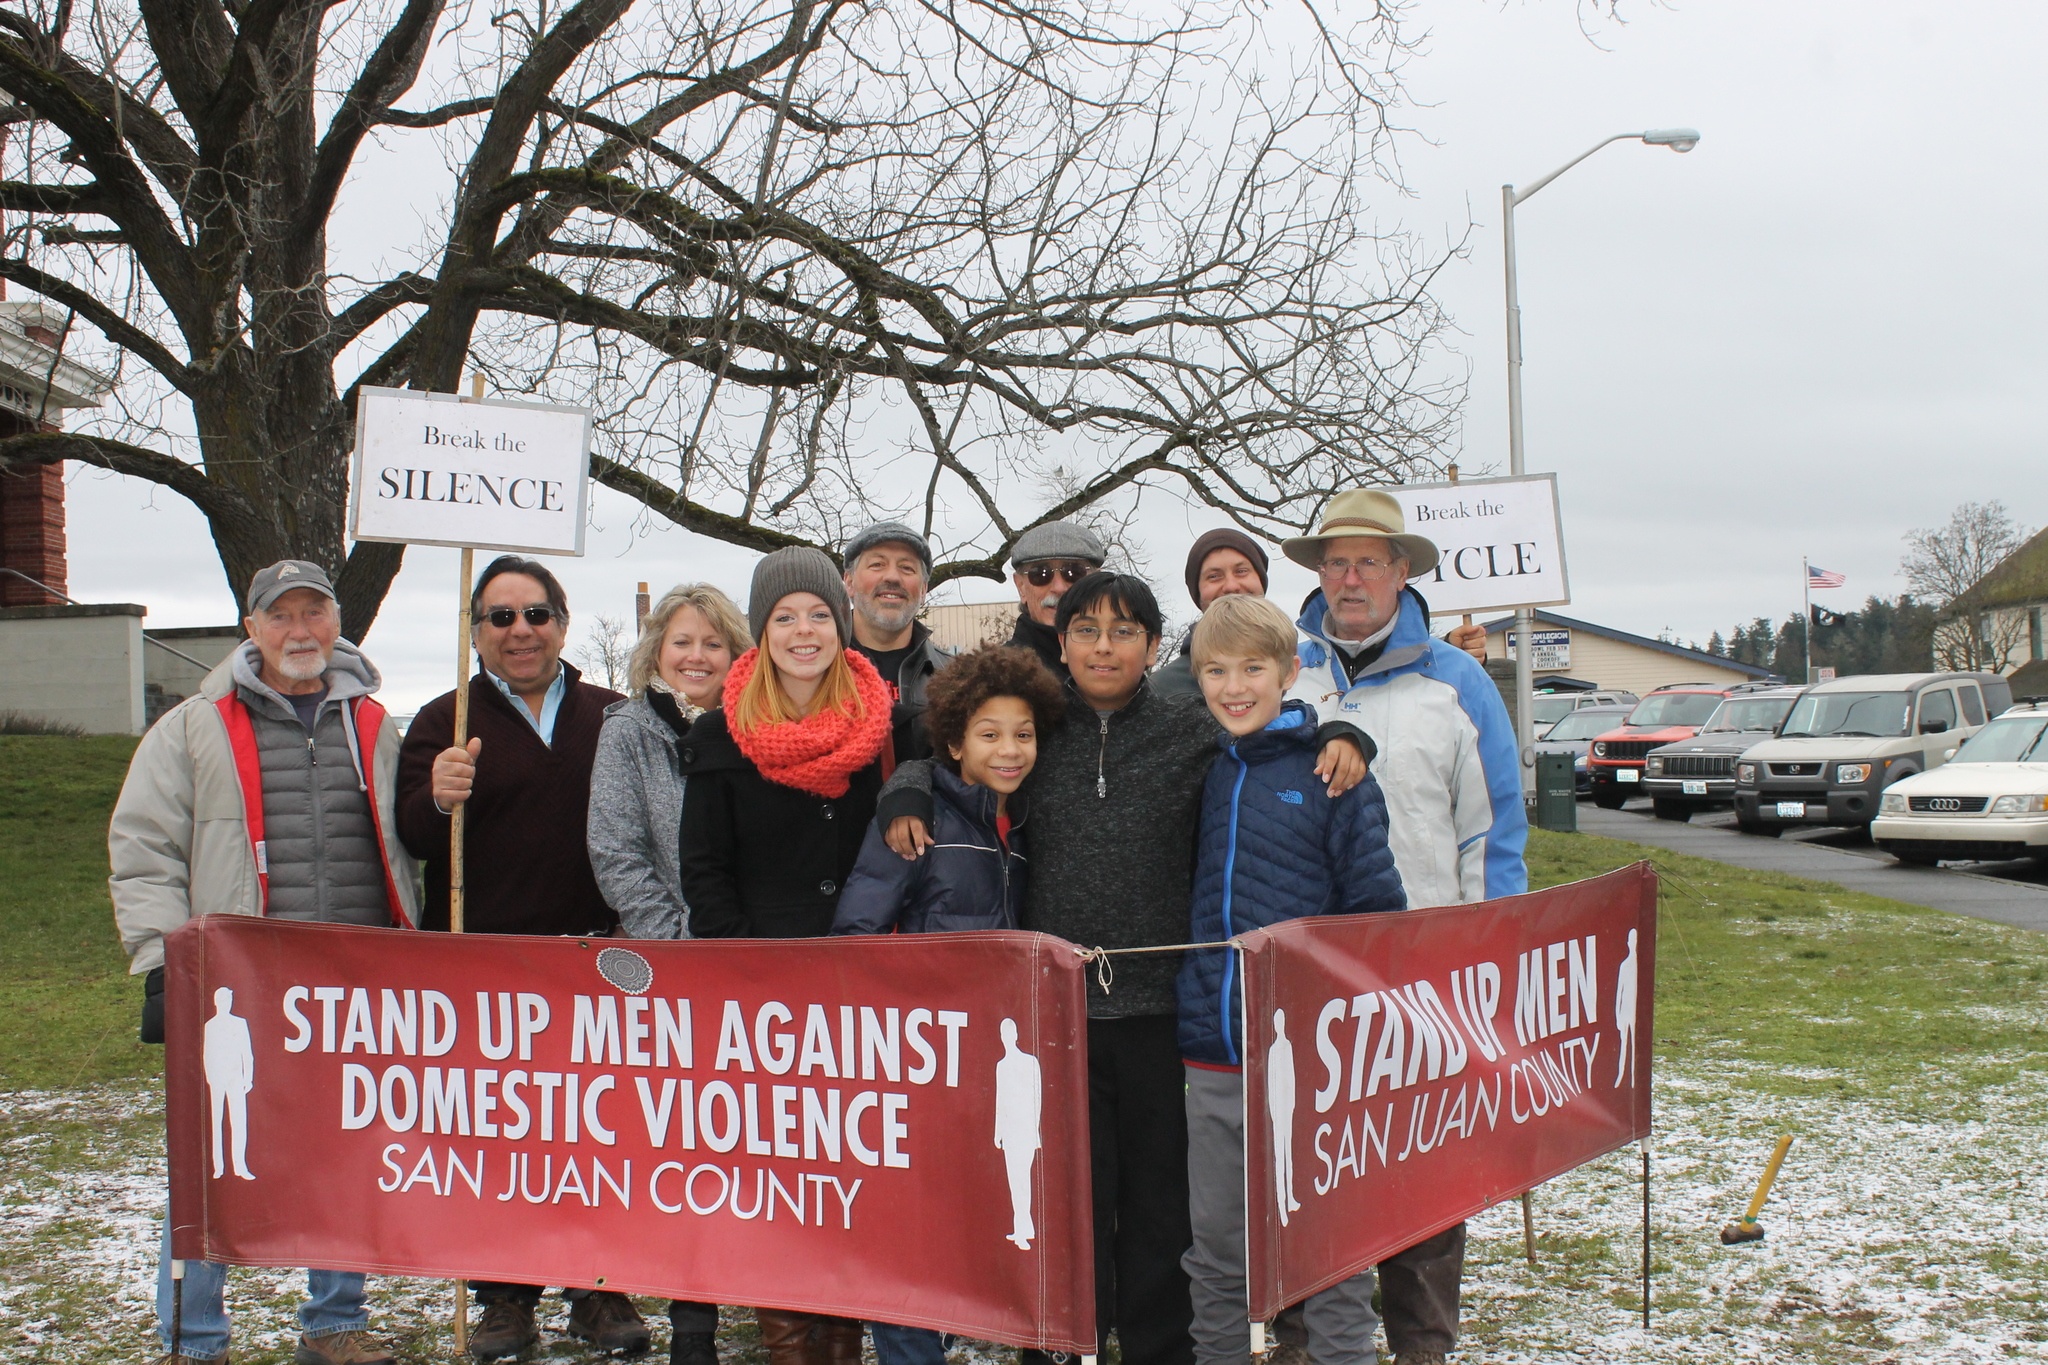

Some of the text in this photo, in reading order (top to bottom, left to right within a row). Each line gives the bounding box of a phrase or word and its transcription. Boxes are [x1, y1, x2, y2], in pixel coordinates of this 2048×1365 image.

[424, 425, 527, 453] Break the
[379, 466, 564, 512] SILENCE
[1416, 499, 1505, 522] Break the
[1407, 541, 1541, 585] YCLE
[1543, 632, 1568, 640] LEGION
[283, 985, 968, 1088] STAND UP MEN AGAINST
[1315, 935, 1597, 1112] STAND UP MEN
[341, 1063, 910, 1169] DOMESTIC VIOLENCE
[1314, 1032, 1600, 1196] SAN JUAN COUNTY
[377, 1143, 863, 1230] SAN JUAN COUNTY
